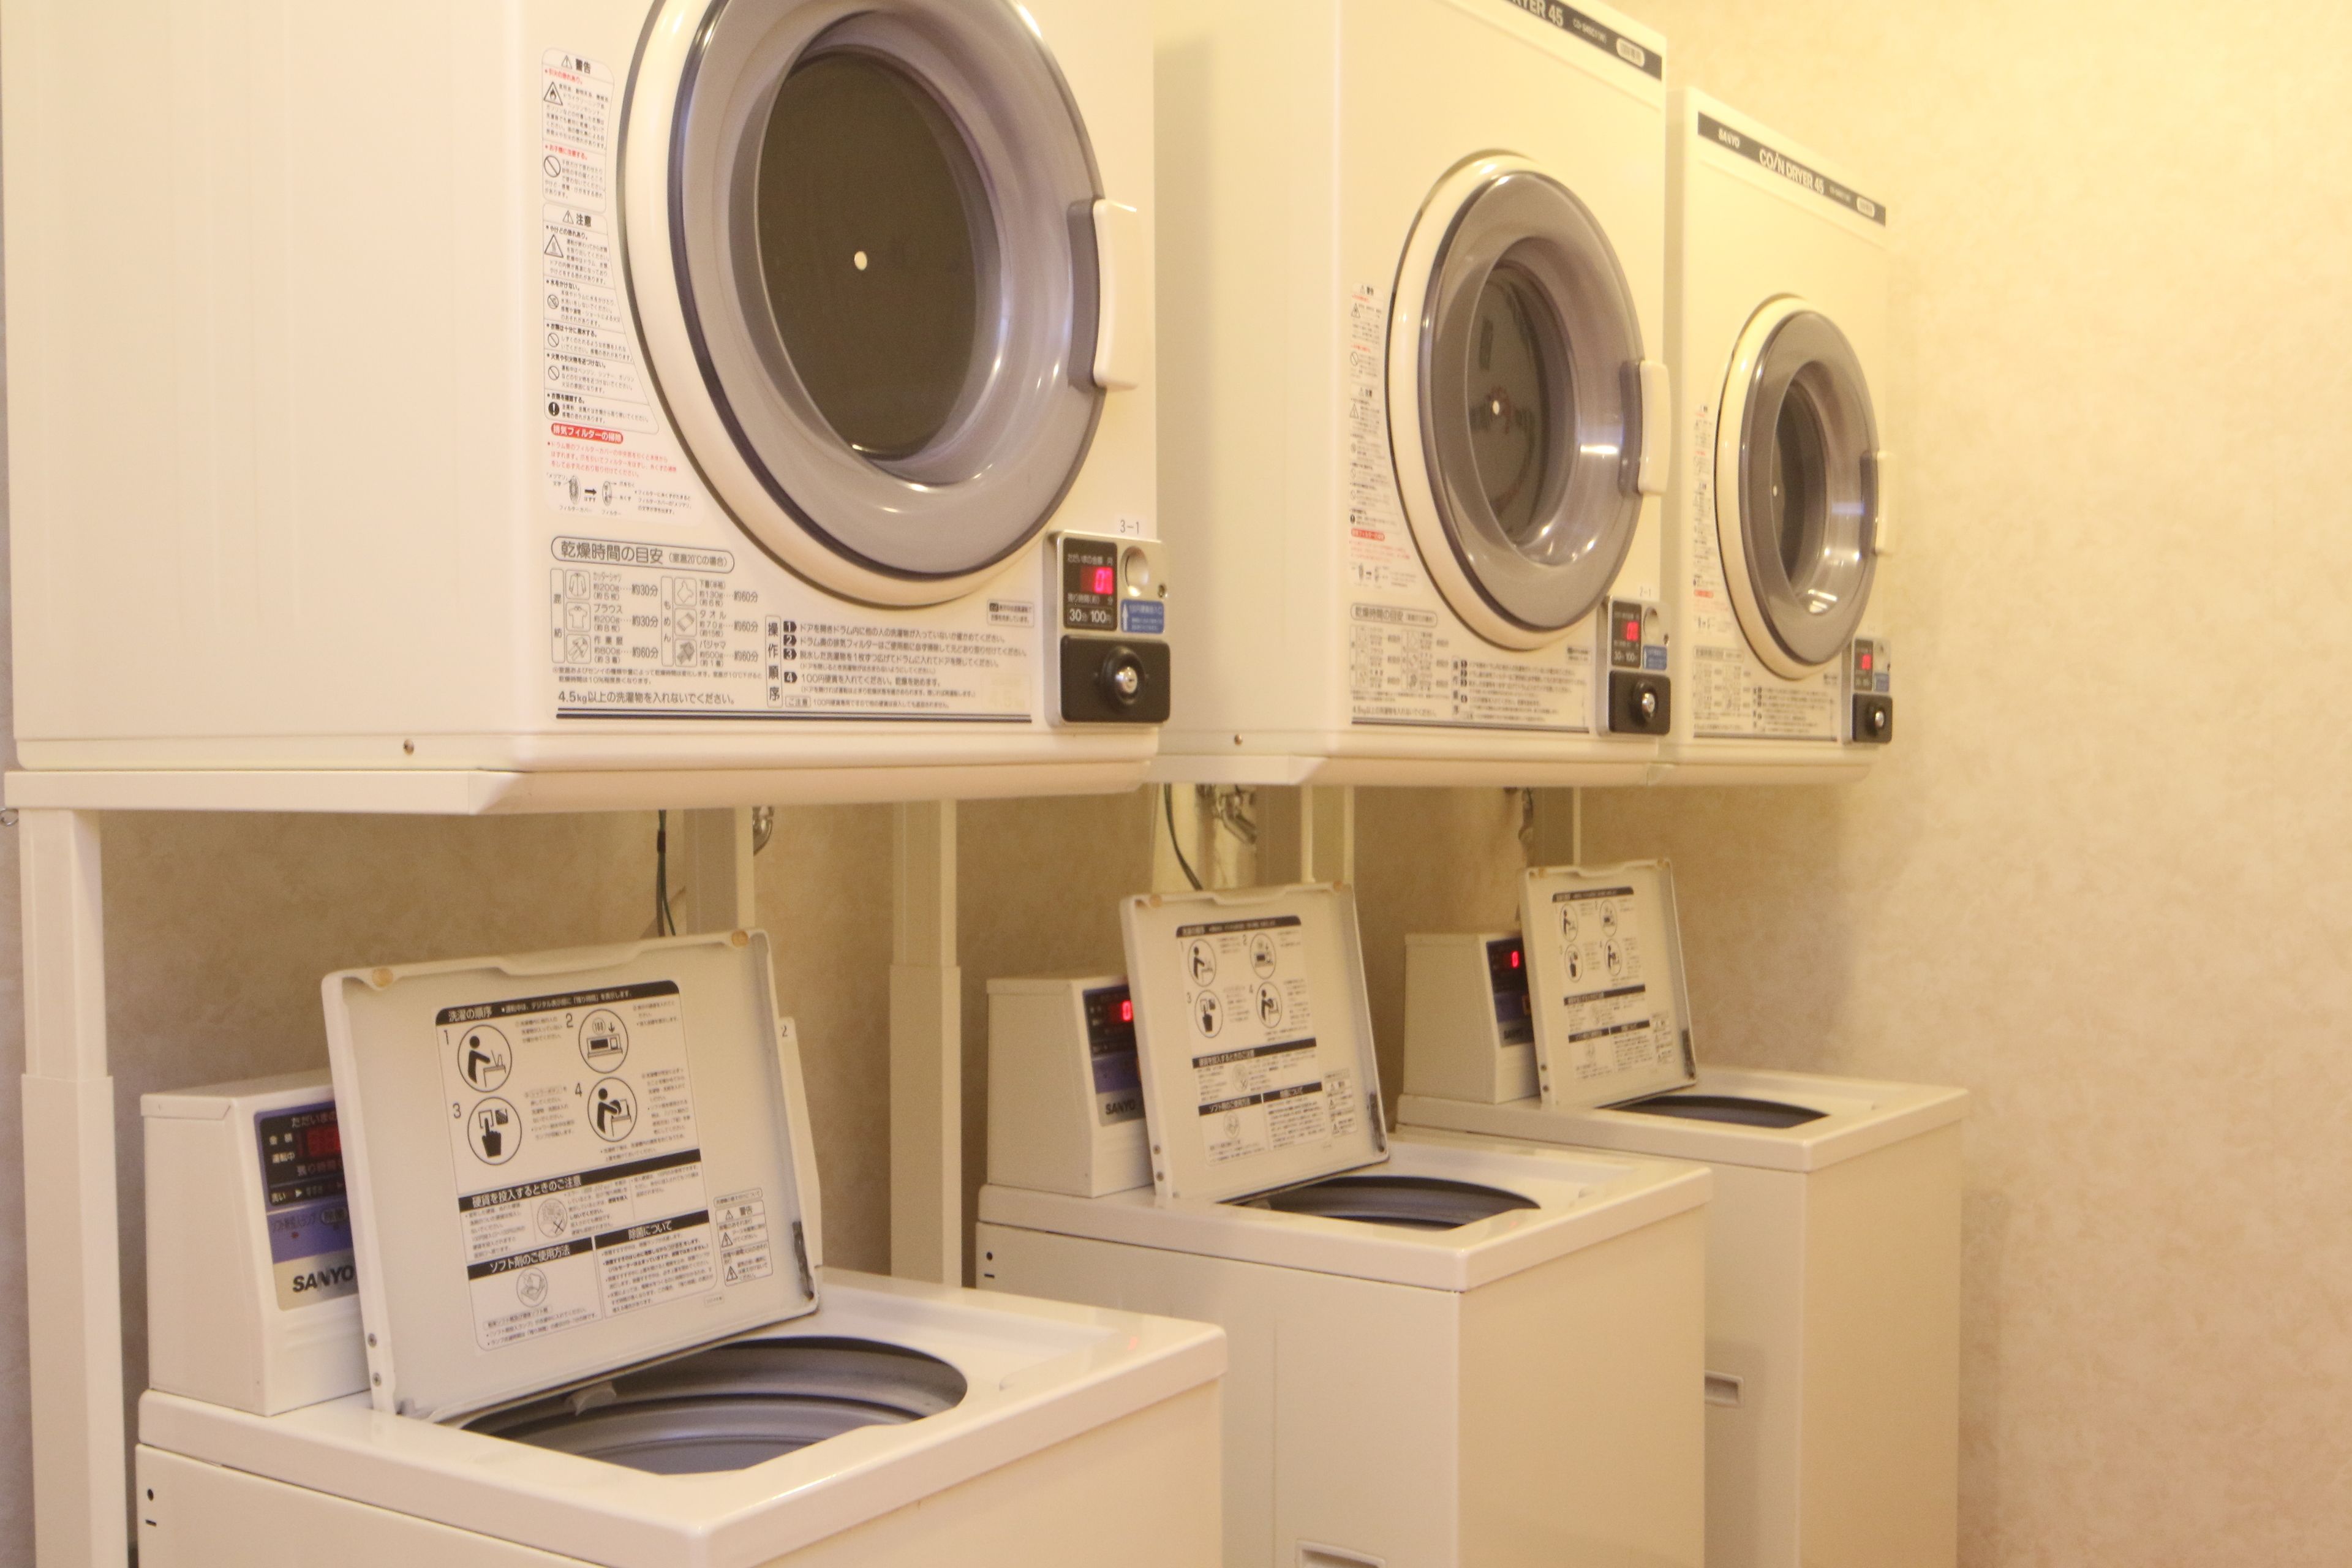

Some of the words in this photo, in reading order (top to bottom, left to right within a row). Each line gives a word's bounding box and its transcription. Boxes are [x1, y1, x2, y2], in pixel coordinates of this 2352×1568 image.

[1548, 5, 1563, 27] 45
[1786, 163, 1813, 189] DRYER
[1120, 520, 1140, 535] 3-1
[560, 540, 663, 564] 乾燥時間の目安
[631, 583, 658, 597] 約30分
[734, 590, 758, 603] 約60分
[632, 615, 658, 628] 約30分
[734, 620, 758, 633] 約60分
[632, 646, 658, 659] 約60分
[558, 691, 734, 704] 4.5kg以上の洗濯物を入れないでください。
[1123, 1000, 1133, 1021] 0
[565, 1013, 573, 1028] 2
[443, 1030, 449, 1045] 1
[575, 1083, 582, 1097] 4
[453, 1102, 461, 1119] 3
[1106, 1099, 1136, 1115] SANYO
[292, 1265, 354, 1293] SANYO
